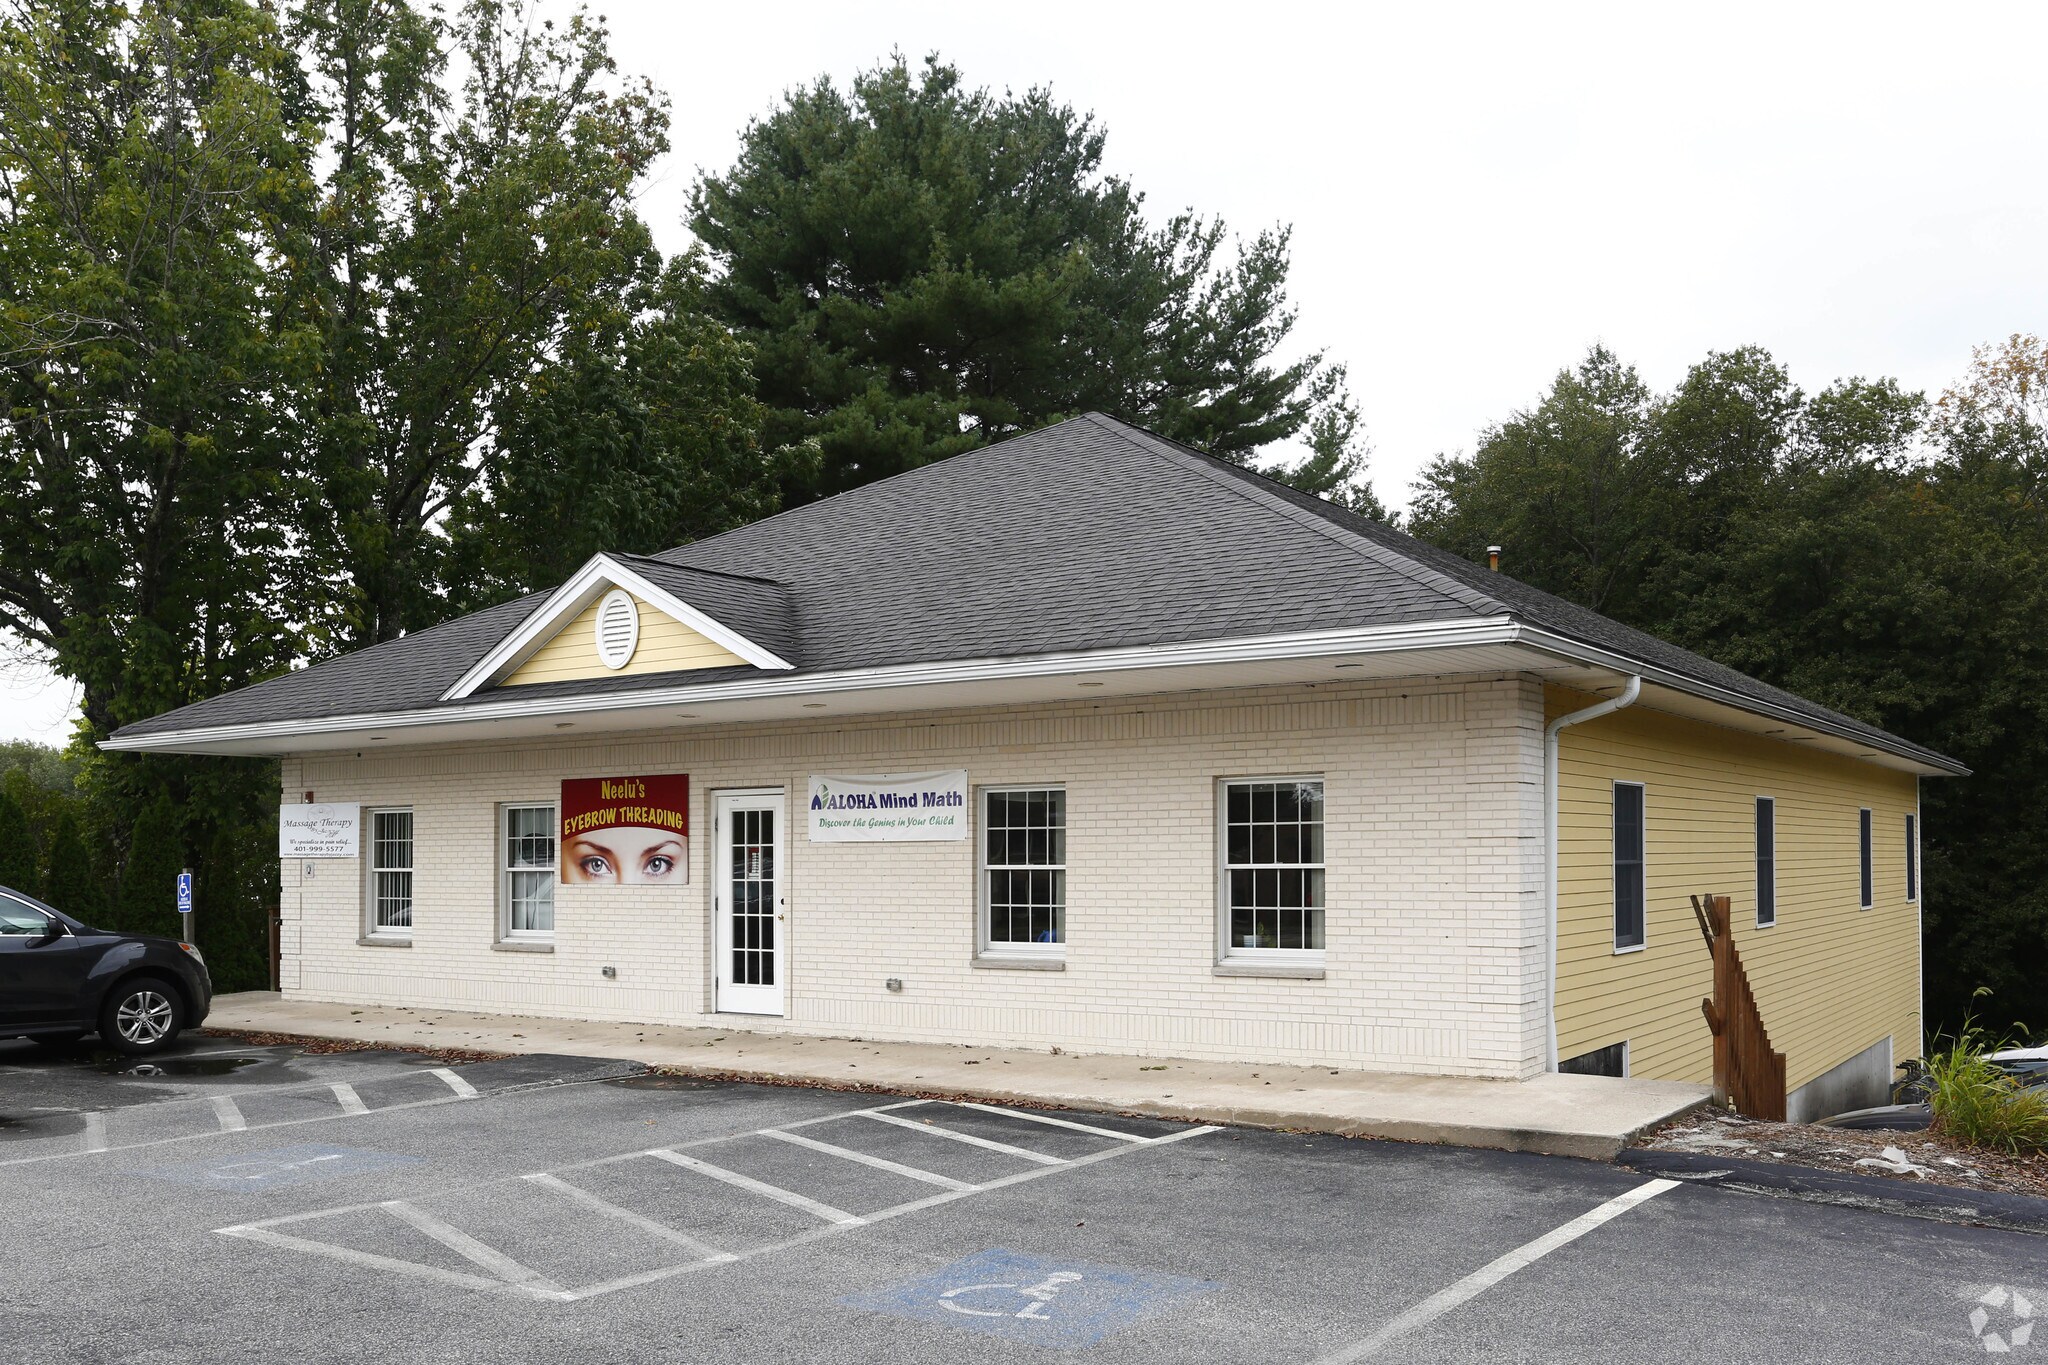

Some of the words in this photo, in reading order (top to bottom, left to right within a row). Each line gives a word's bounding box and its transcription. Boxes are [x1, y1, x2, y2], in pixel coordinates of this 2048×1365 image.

[601, 779, 645, 799] Neelu's
[827, 793, 877, 810] ALOHA
[879, 793, 918, 808] Mind
[922, 791, 963, 807] Math
[284, 820, 318, 830] Massage
[320, 818, 353, 829] Therapy
[564, 807, 616, 835] EYEBROW
[620, 806, 683, 829] THREADING
[819, 817, 851, 828] Discover
[853, 817, 866, 827] the
[868, 817, 896, 829] Genius
[897, 817, 906, 826] in
[906, 816, 926, 828] Your
[929, 815, 954, 826] Child
